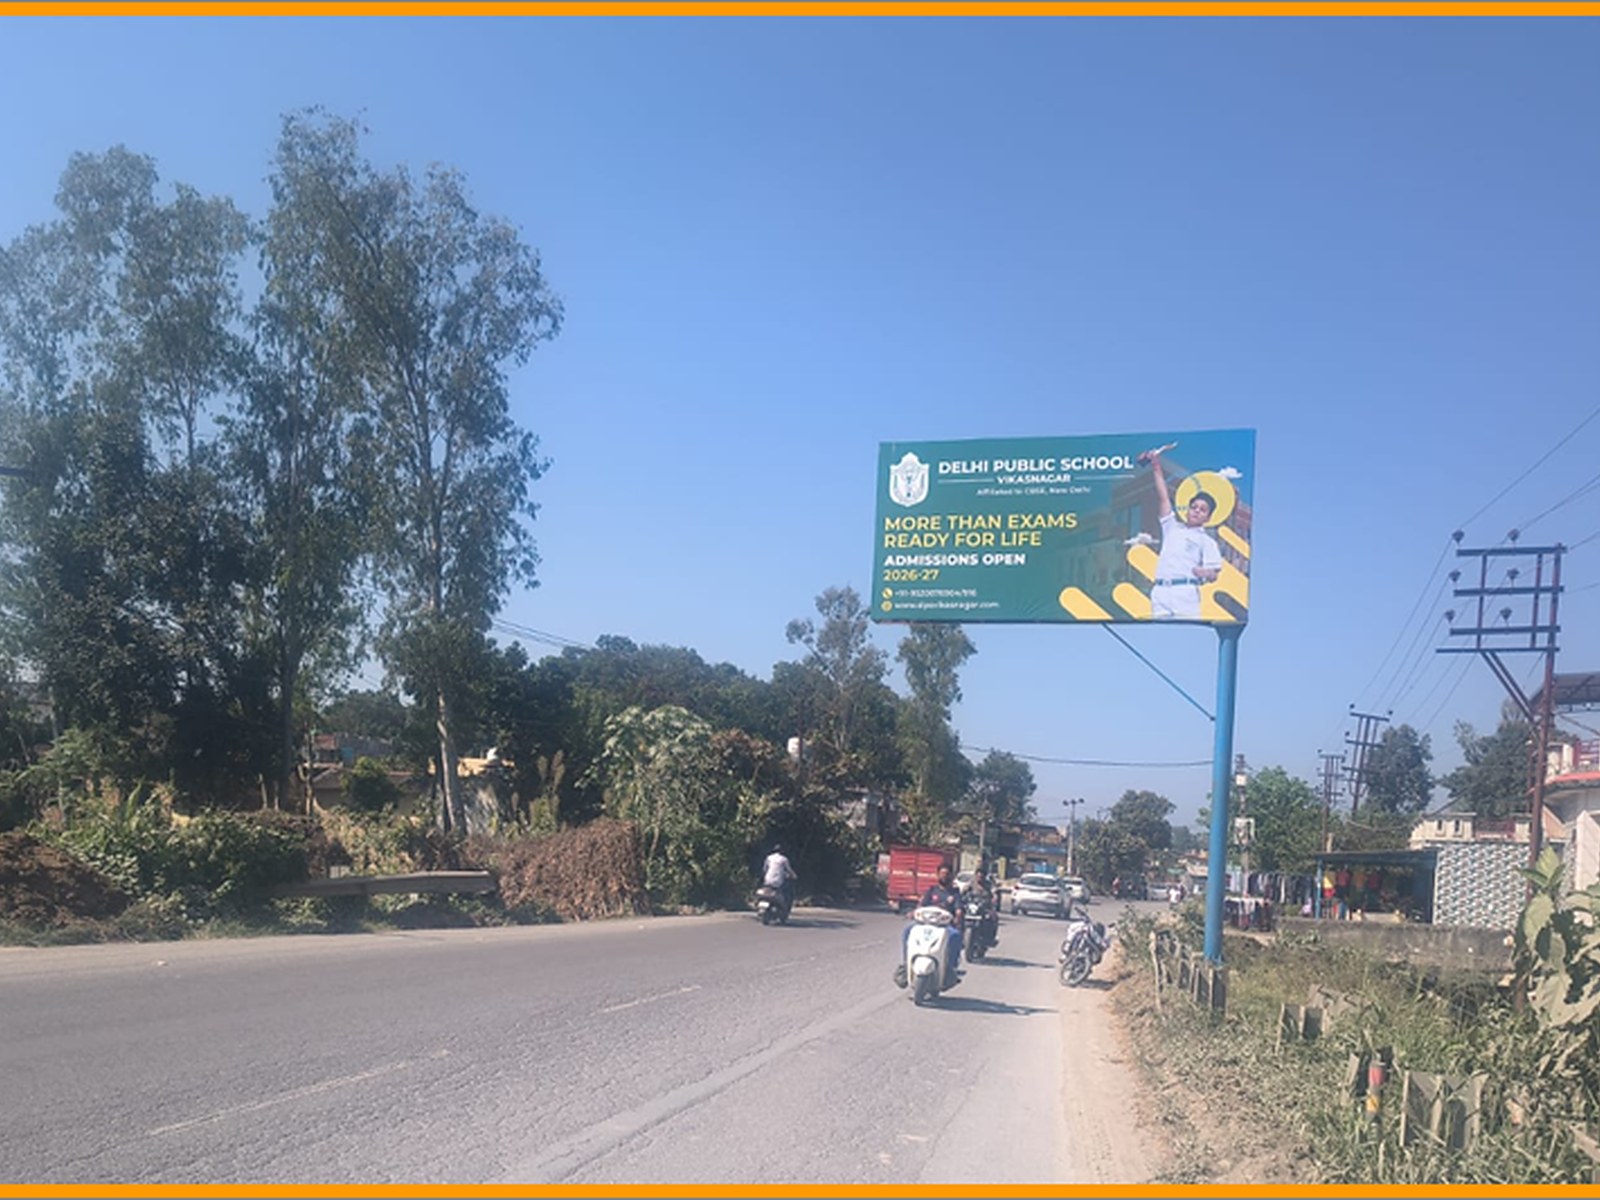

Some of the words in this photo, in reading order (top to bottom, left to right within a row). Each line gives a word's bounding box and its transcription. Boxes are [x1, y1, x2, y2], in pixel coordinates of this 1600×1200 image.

[938, 460, 988, 475] DELHI
[993, 458, 1055, 473] PUBLIC
[1060, 455, 1134, 471] SCHOOL
[996, 474, 1072, 484] VIKASNAGAR
[884, 516, 942, 531] MORE
[947, 514, 1002, 530] THAN
[1007, 513, 1078, 528] EXAMS
[883, 532, 949, 548] READY
[954, 531, 995, 547] FOR
[1000, 531, 1042, 546] LIFE
[883, 554, 979, 567] ADMISSIONS
[982, 553, 1026, 566] OPEN
[882, 568, 939, 581] 2026-27
